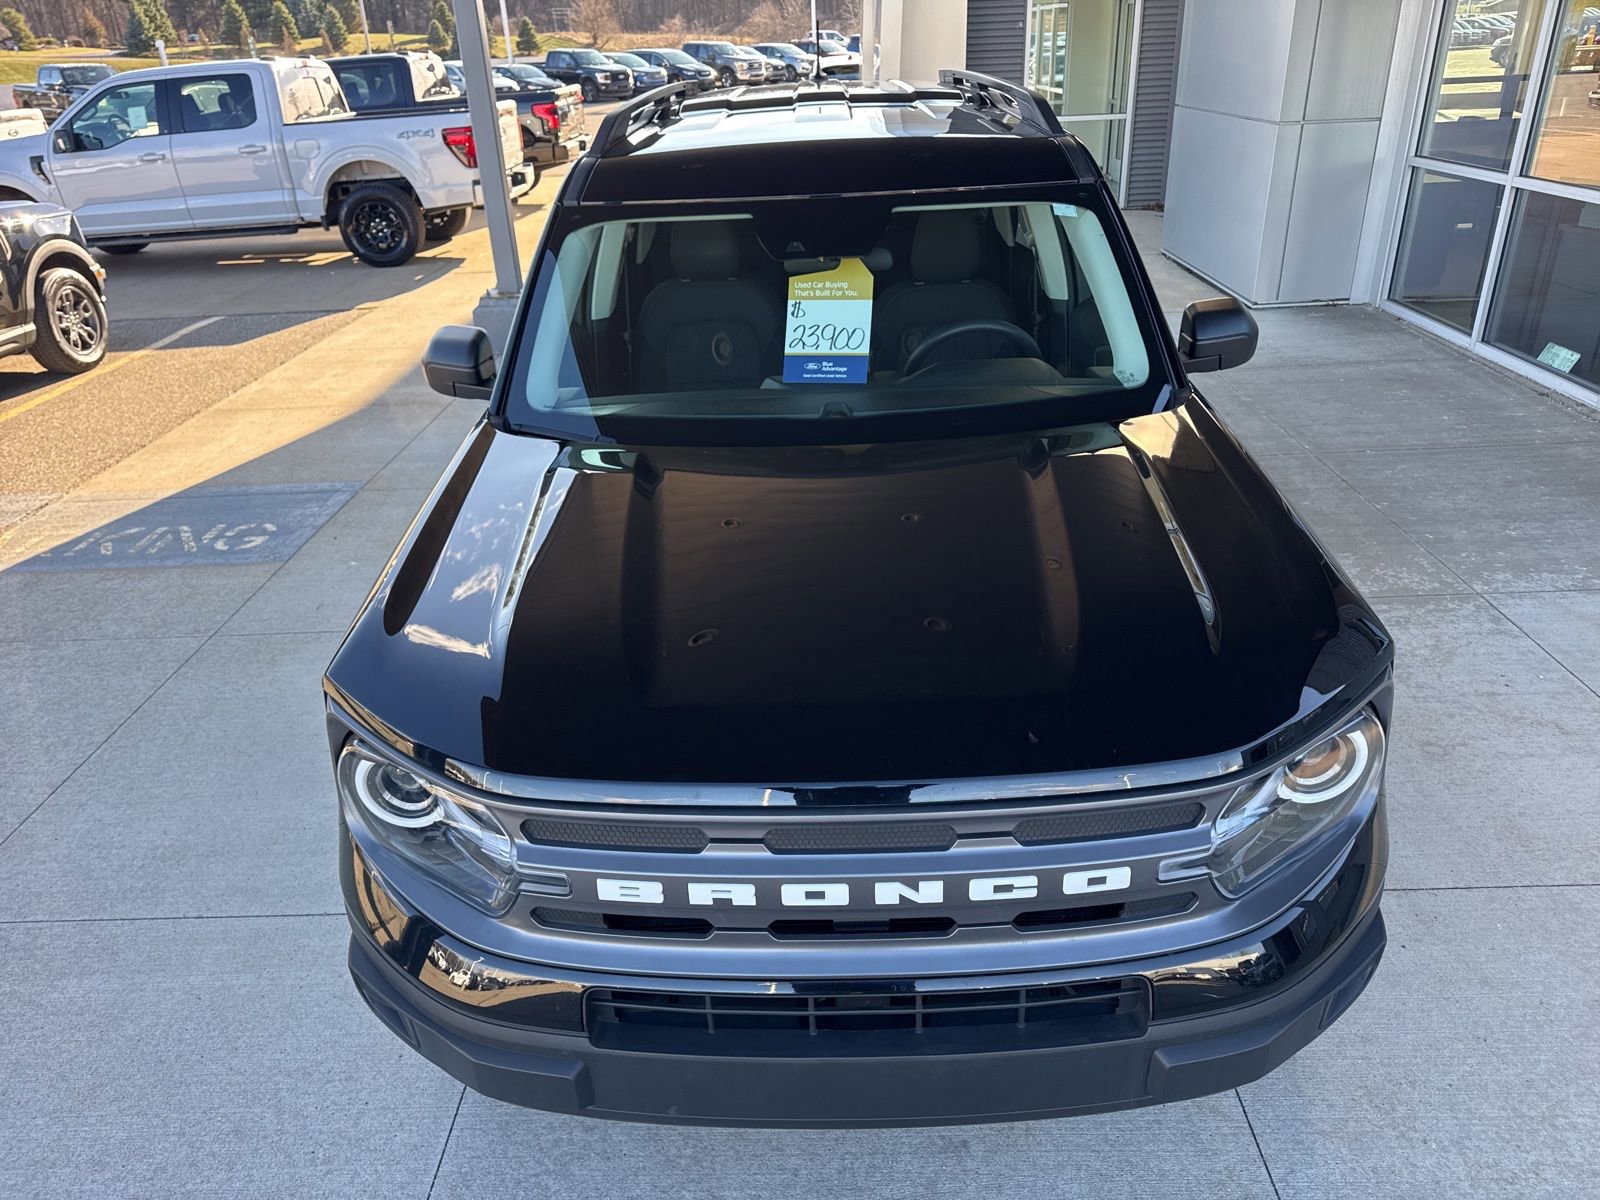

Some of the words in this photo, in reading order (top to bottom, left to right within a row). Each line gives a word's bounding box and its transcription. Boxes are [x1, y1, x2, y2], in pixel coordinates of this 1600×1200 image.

[794, 281, 811, 289] Used
[812, 281, 823, 289] Car
[825, 281, 848, 289] Buying
[794, 289, 814, 297] That's
[815, 289, 830, 297] Built
[831, 289, 843, 297] For
[790, 300, 806, 319] $
[596, 866, 1132, 906] BRONCO
